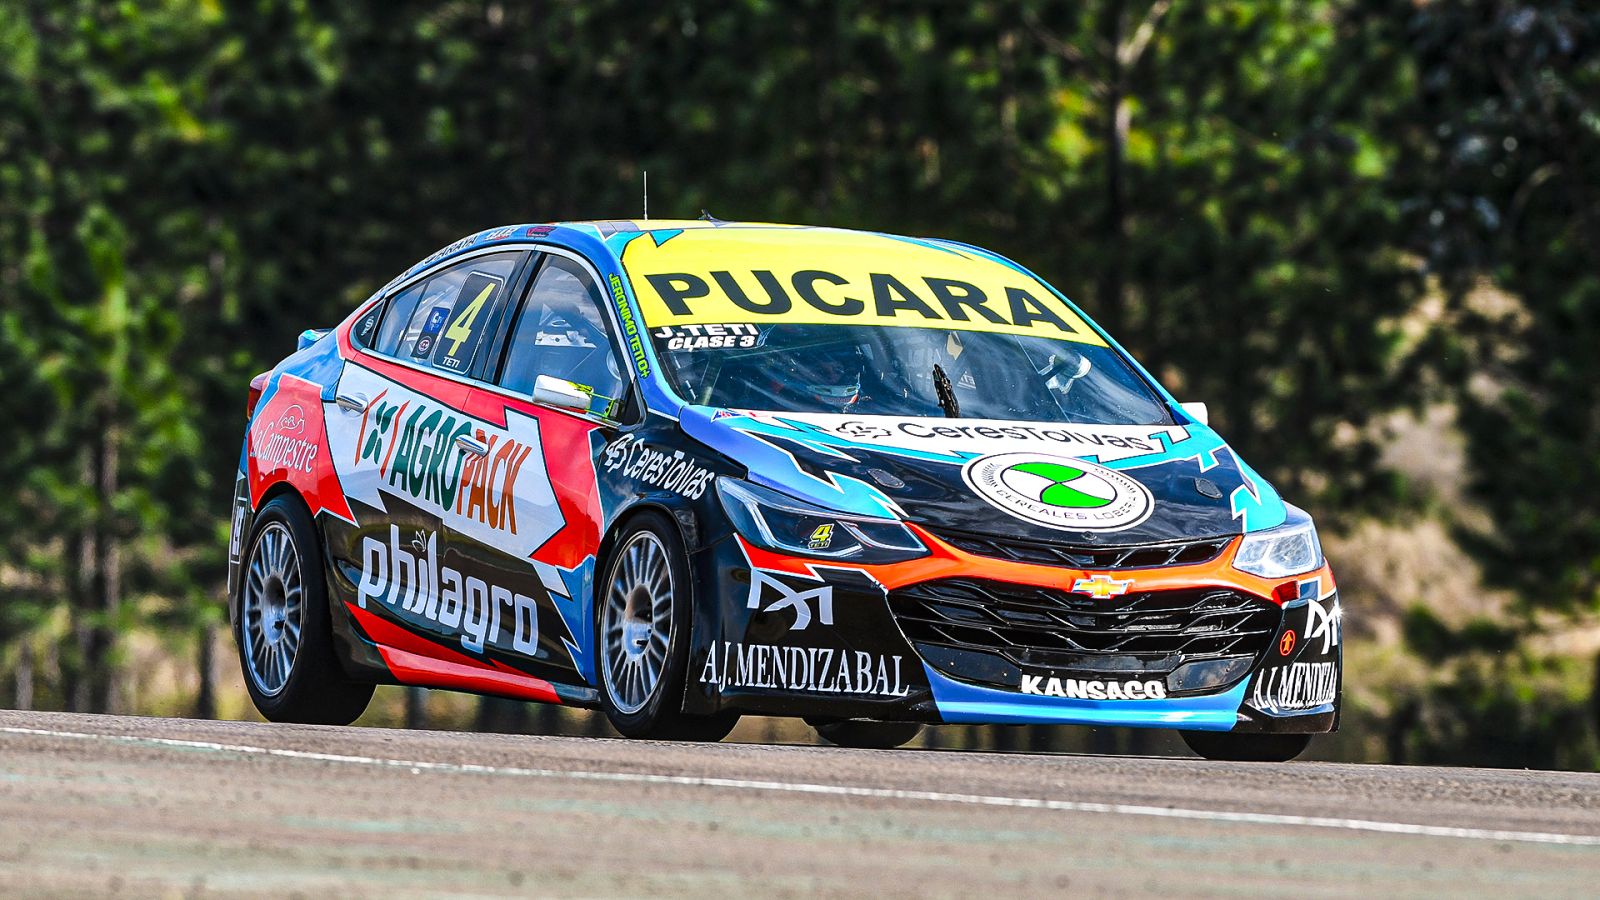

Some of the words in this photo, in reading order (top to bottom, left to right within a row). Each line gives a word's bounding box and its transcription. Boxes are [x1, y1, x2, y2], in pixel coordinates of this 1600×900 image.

[609, 273, 637, 336] JERONIMO
[643, 269, 1080, 335] PUCARA
[444, 281, 496, 357] 4
[654, 323, 759, 338] J.TETI
[667, 336, 737, 352] CLASE
[739, 335, 756, 348] 3
[442, 356, 461, 369] TETI
[389, 403, 532, 536] AGROPACK
[995, 488, 1087, 520] CEREALES
[811, 524, 832, 542] 4
[357, 524, 539, 654] philagro
[1021, 674, 1167, 700] KANSACO
